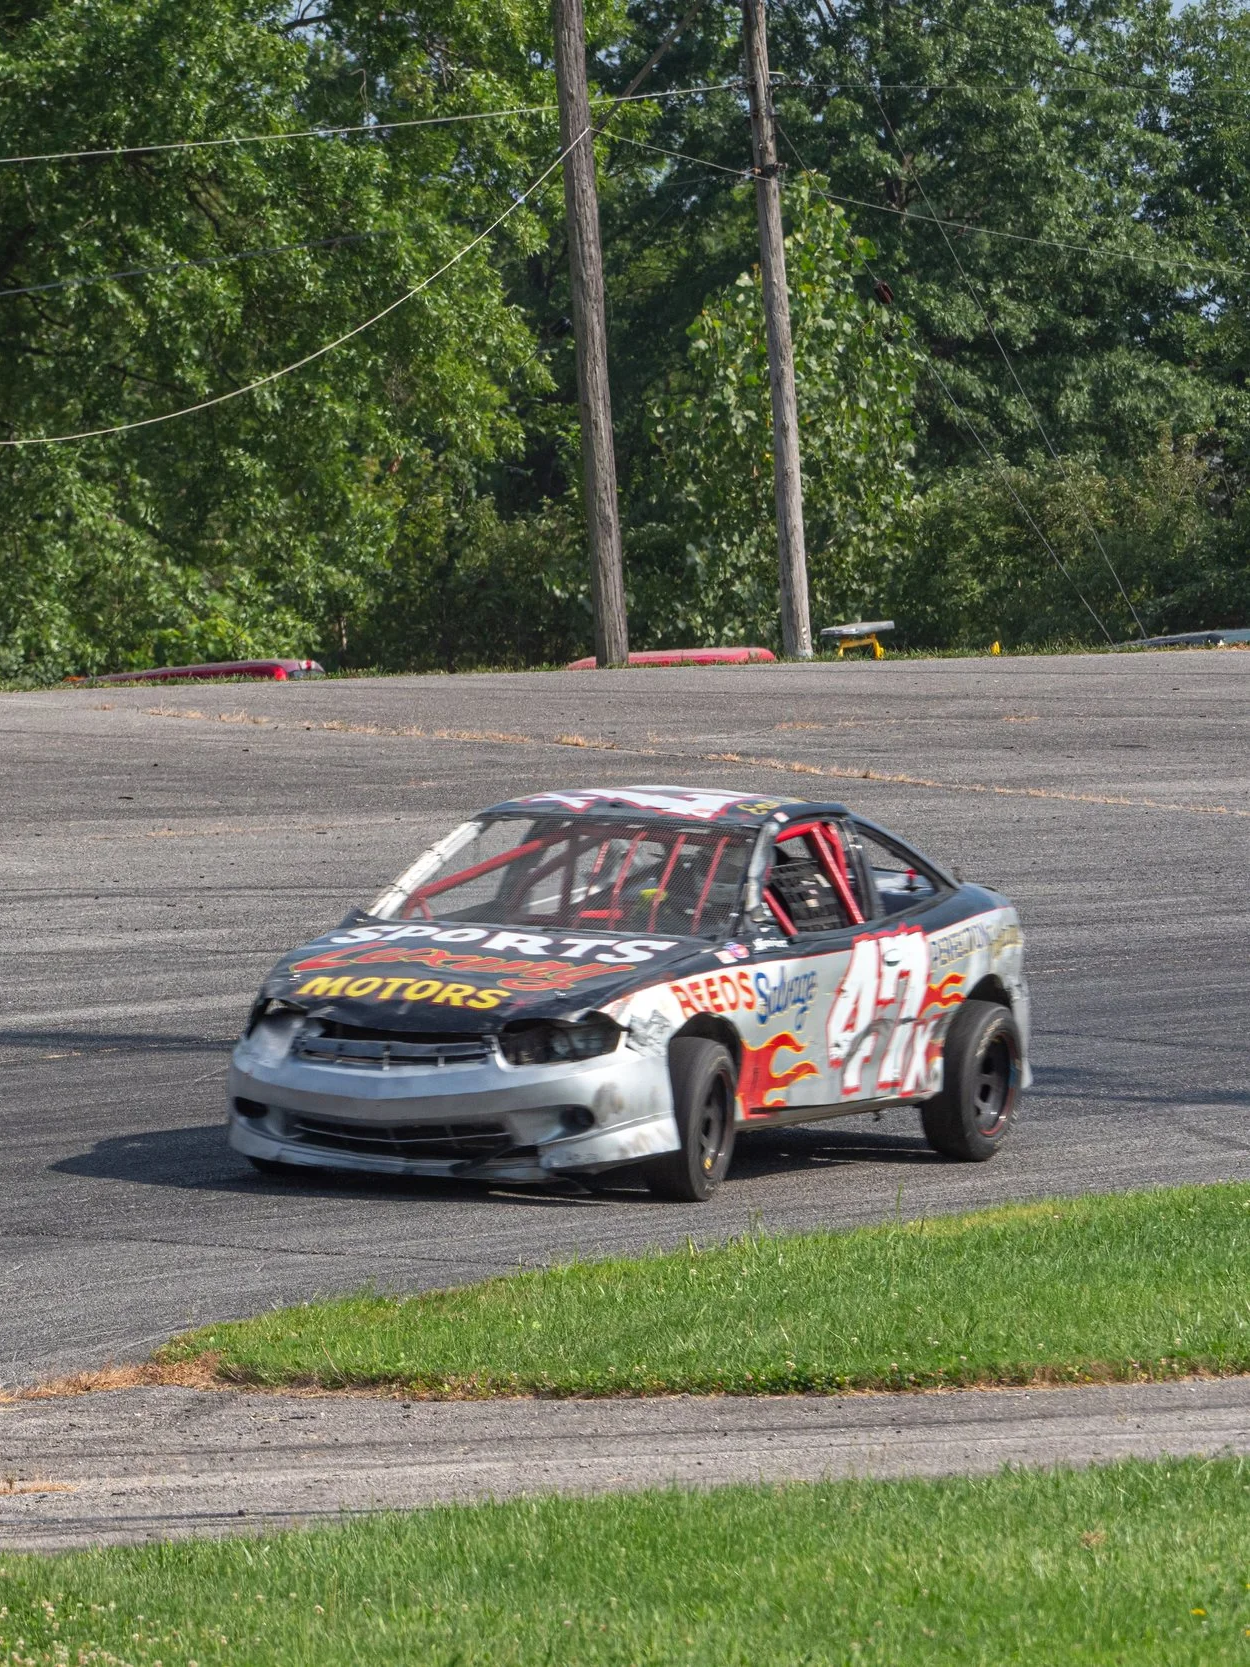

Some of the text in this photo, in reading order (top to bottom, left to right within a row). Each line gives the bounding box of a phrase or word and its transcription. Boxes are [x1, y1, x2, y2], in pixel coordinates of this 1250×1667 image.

[330, 924, 679, 964] SPORTS
[296, 975, 512, 1010] MOTORS
[670, 970, 758, 1021] REEDS
